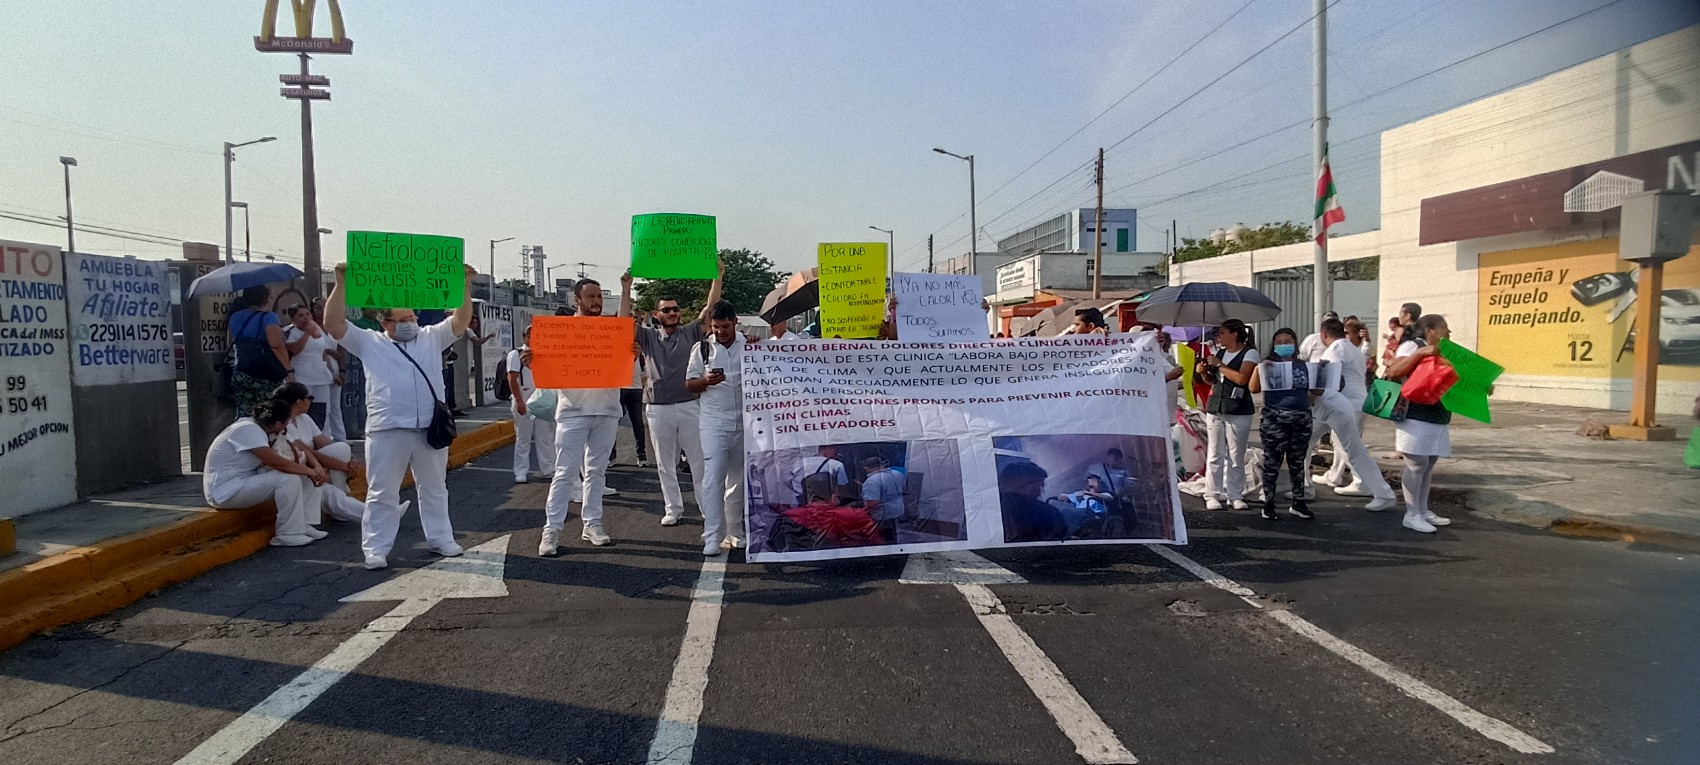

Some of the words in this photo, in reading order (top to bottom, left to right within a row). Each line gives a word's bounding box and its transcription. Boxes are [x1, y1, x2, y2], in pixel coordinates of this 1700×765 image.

[271, 39, 331, 48] McDonald's
[351, 233, 461, 274] Nefrología
[647, 249, 659, 258] DE
[824, 244, 846, 258] POR
[849, 246, 866, 256] UNA
[80, 259, 154, 278] AMUEBLA
[351, 260, 416, 277] pacientes
[439, 263, 456, 274] en
[821, 263, 862, 275] ESTANCIA
[1489, 267, 1553, 286] Empeña
[1558, 269, 1569, 284] y
[83, 278, 106, 291] TU
[112, 280, 160, 295] HOGAR
[355, 272, 417, 288] DIALISIS
[426, 277, 449, 290] sin
[825, 277, 877, 291] CONFORTABLE
[900, 275, 920, 293] ¡YA
[925, 280, 940, 291] NO
[944, 276, 966, 290] MÁS
[0, 280, 64, 300] TAMENTO
[826, 293, 858, 304] CALIDAD
[1489, 287, 1549, 308] síguelo
[919, 292, 956, 307] CALOR!
[535, 319, 576, 330] PACIENTES
[581, 323, 595, 331] CON
[901, 314, 938, 326] TODOS
[1489, 306, 1585, 328] manejando.
[40, 328, 65, 340] IMSS
[89, 323, 168, 342] 2291141576
[1567, 332, 1590, 340] Hasta
[536, 342, 550, 350] SIN
[822, 342, 878, 351] BERNAL
[881, 342, 946, 350] DOLORES
[949, 341, 1017, 350] DIRECTOR
[1020, 339, 1071, 348] CLINICA
[1074, 337, 1134, 348] UMAE#14
[1567, 340, 1593, 361] 12
[79, 343, 170, 367] Betterware
[744, 355, 758, 363] EL
[763, 354, 830, 364] PERSONAL
[836, 355, 852, 364] DE
[858, 354, 889, 363] ESTA
[894, 353, 944, 362] CLINICA
[1009, 350, 1038, 361] BAJO
[1111, 346, 1137, 355] POR
[575, 368, 602, 377] NORTE
[744, 365, 782, 375] FALTA
[817, 367, 858, 376] CLIMA
[866, 367, 874, 375] Y
[883, 366, 911, 376] QUE
[920, 363, 1013, 373] ACTUALMENTE
[1021, 363, 1045, 372] LOS
[1053, 355, 1133, 371] ELEVADORES
[1140, 355, 1155, 365] NO
[7, 376, 26, 391] 99
[744, 375, 822, 388] FUNCIONAN
[829, 377, 944, 387] ADECUADAMENTE
[951, 377, 968, 386] LO
[974, 376, 1001, 386] QUE
[1007, 373, 1059, 384] GENERA
[1151, 369, 1157, 377] Y
[745, 387, 799, 400] RIESGOS
[802, 386, 819, 394] AL
[746, 398, 810, 412] EXIGIMOS
[813, 397, 899, 406] SOLUCIONES
[903, 396, 965, 405] PRONTAS
[968, 396, 1004, 404] PARA
[1007, 391, 1072, 402] PREVENIR
[1075, 388, 1148, 398] ACCIDENTES
[9, 397, 28, 413] 50
[31, 395, 47, 411] 41
[774, 412, 797, 421] SIN
[801, 409, 851, 419] CLIMAS
[776, 424, 800, 434] SIN
[804, 419, 896, 432] ELEVADORES
[8, 427, 38, 452] MEJOR
[39, 422, 69, 435] OPCION
